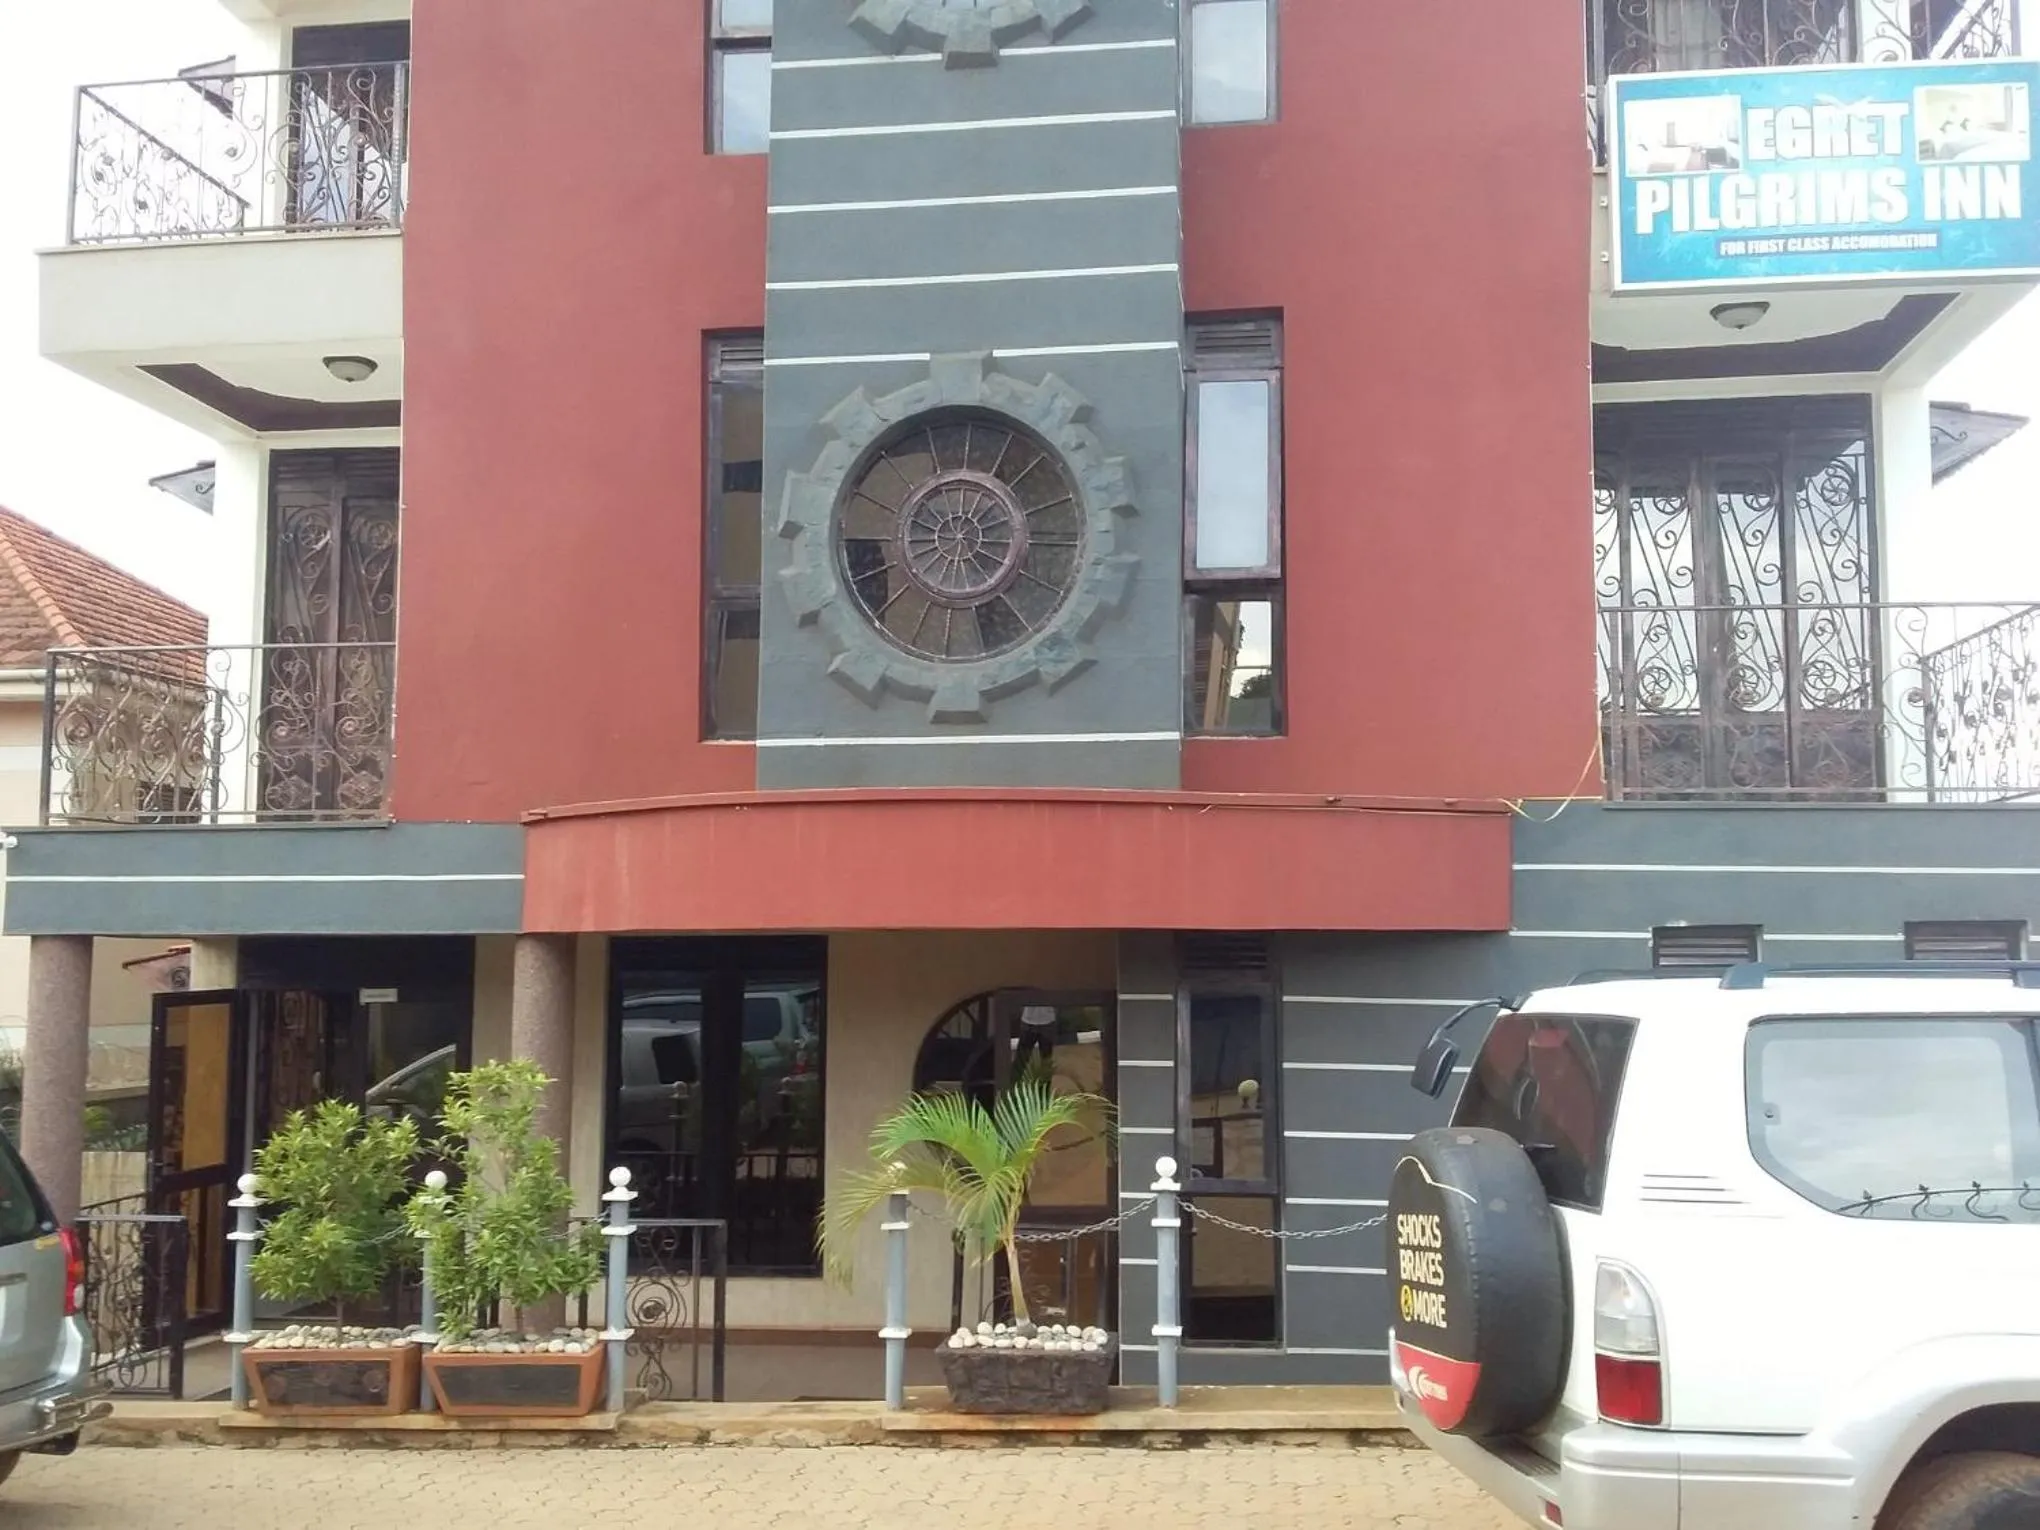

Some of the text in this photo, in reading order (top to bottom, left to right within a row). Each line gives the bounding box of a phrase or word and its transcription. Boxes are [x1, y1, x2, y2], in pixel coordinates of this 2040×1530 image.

[1747, 102, 1910, 160] EGRET
[1635, 164, 2022, 234] PILGRIMS INN
[1720, 241, 1746, 256] FOR
[1747, 238, 1786, 254] FIRST
[1787, 236, 1830, 253] CLASS
[1397, 1214, 1442, 1249] SHOCKS
[1400, 1249, 1444, 1287] BRAKES
[1412, 1289, 1448, 1328] MORE
